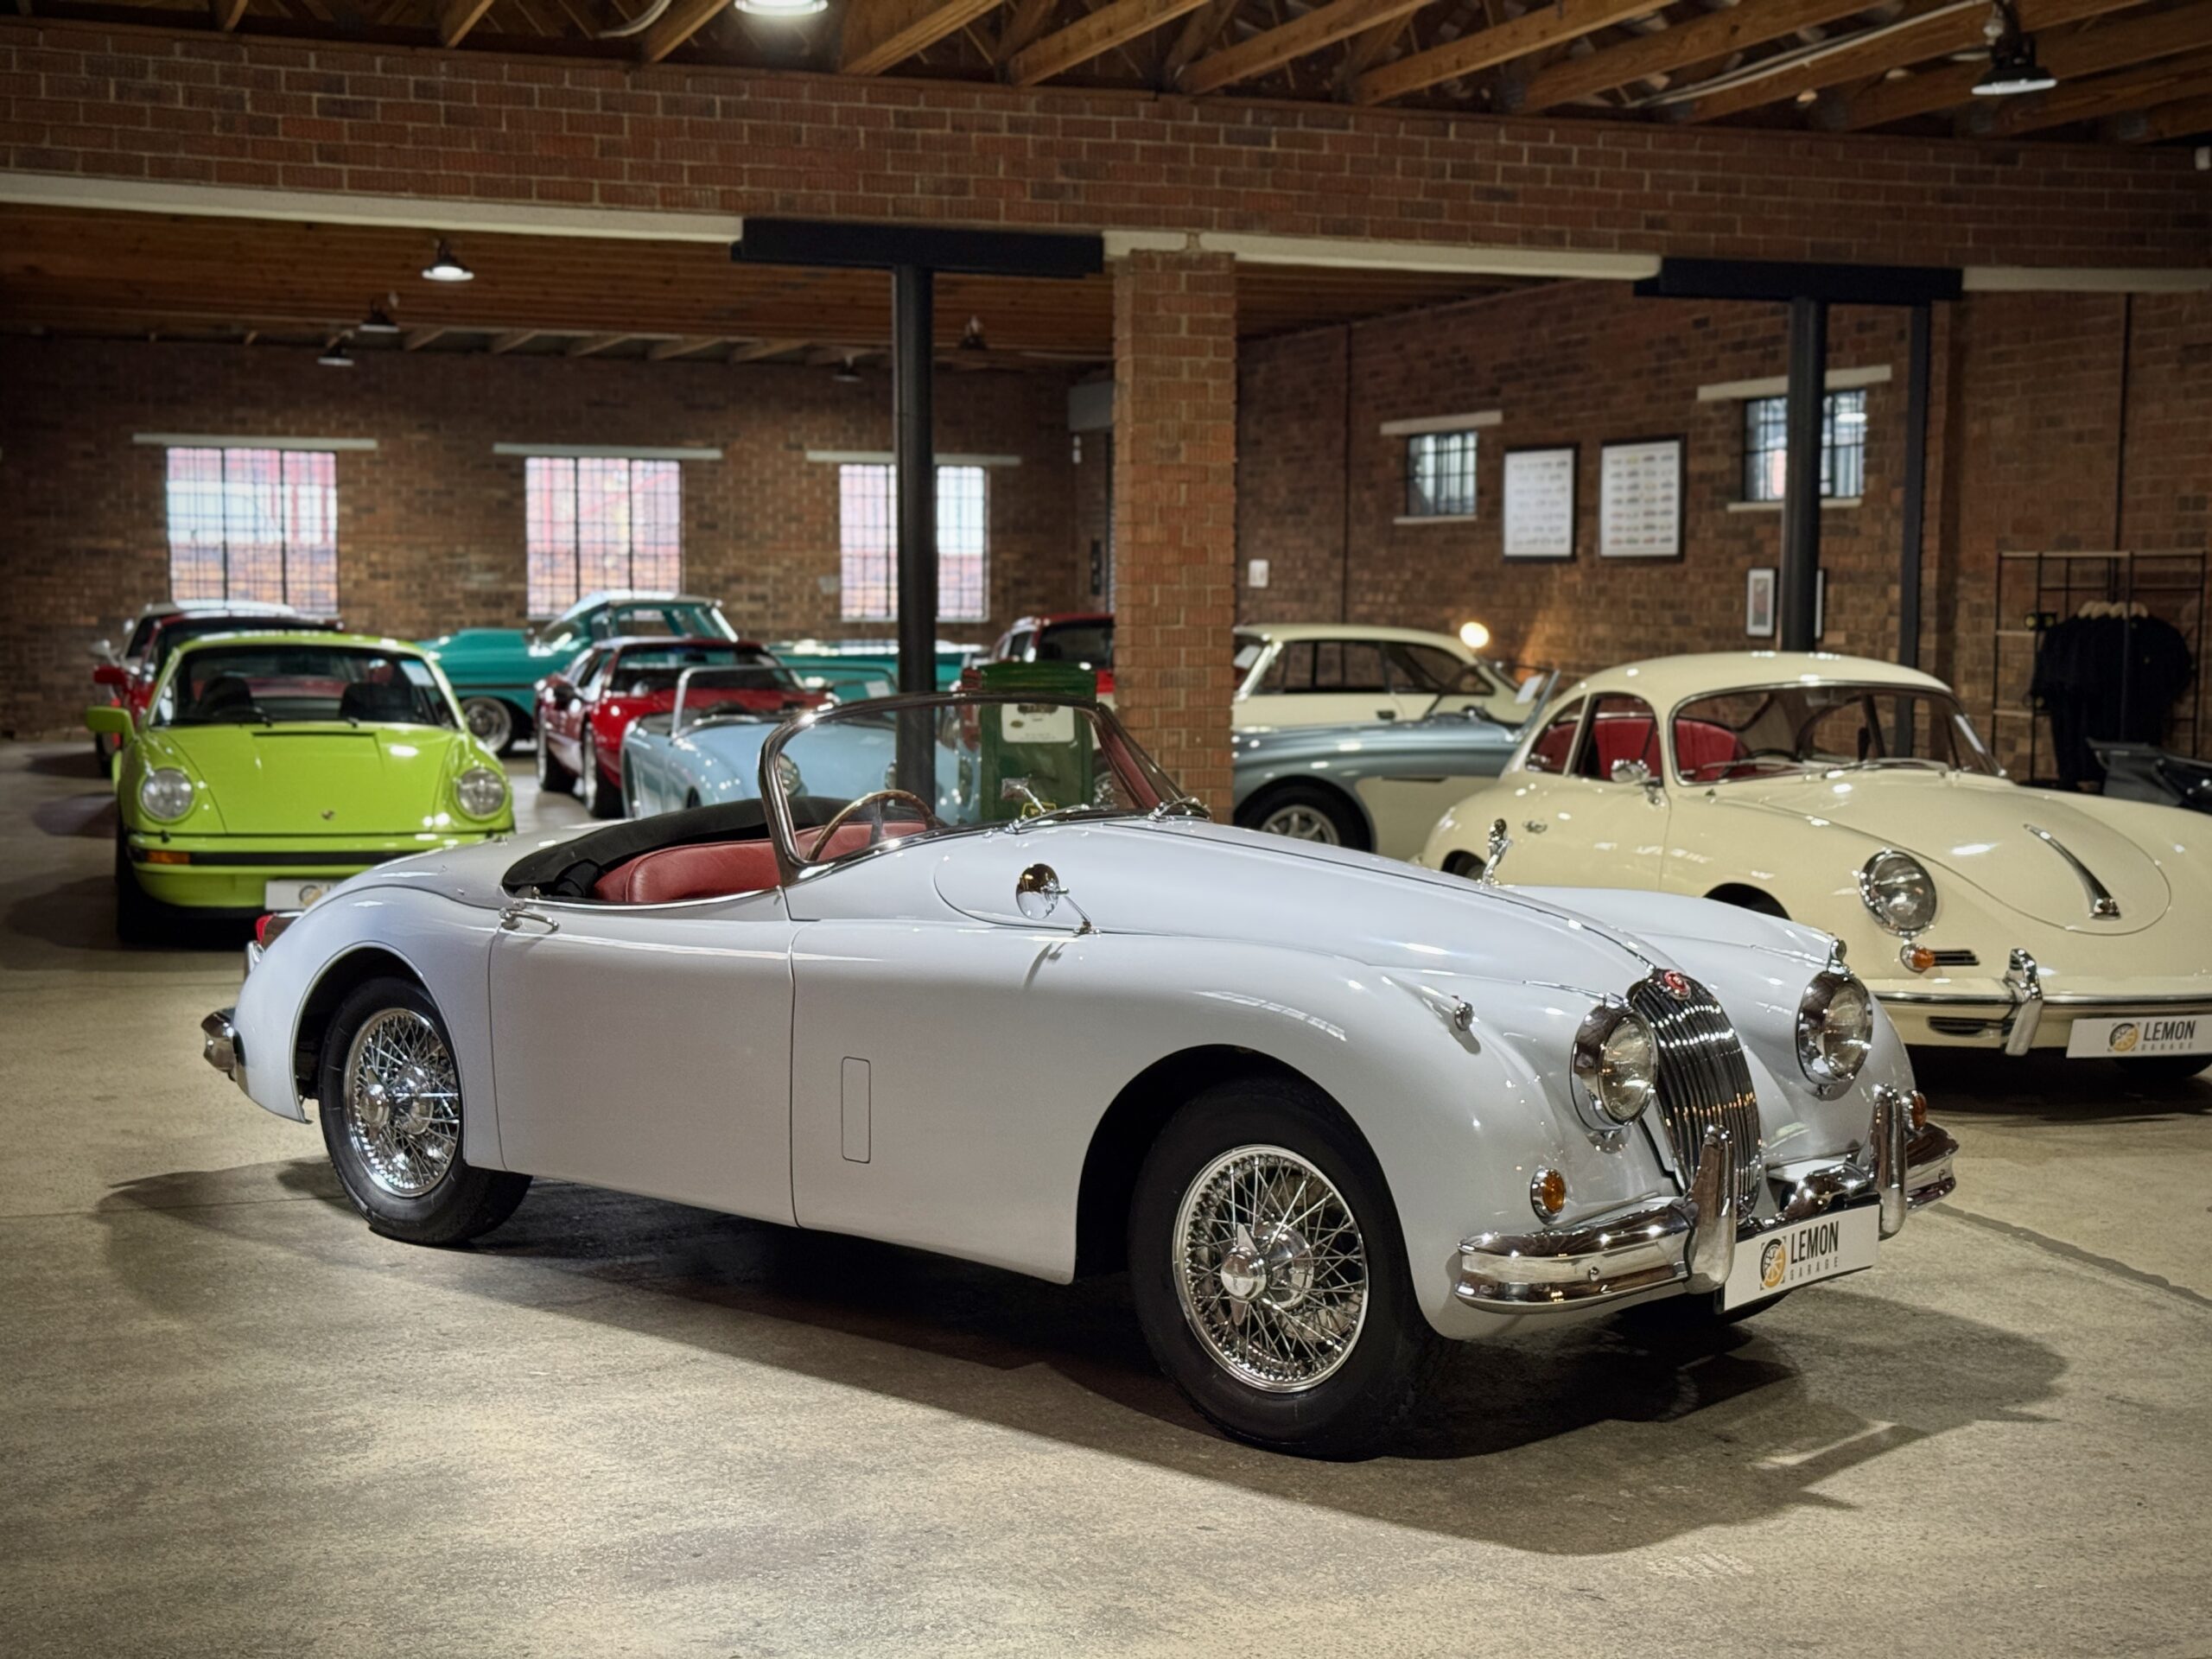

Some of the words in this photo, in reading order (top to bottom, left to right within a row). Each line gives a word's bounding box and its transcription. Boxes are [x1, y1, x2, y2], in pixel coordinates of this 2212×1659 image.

[2143, 1020, 2196, 1041] LEMON
[1790, 1220, 1840, 1265] LEMON
[1789, 1255, 1839, 1281] GARAGE
